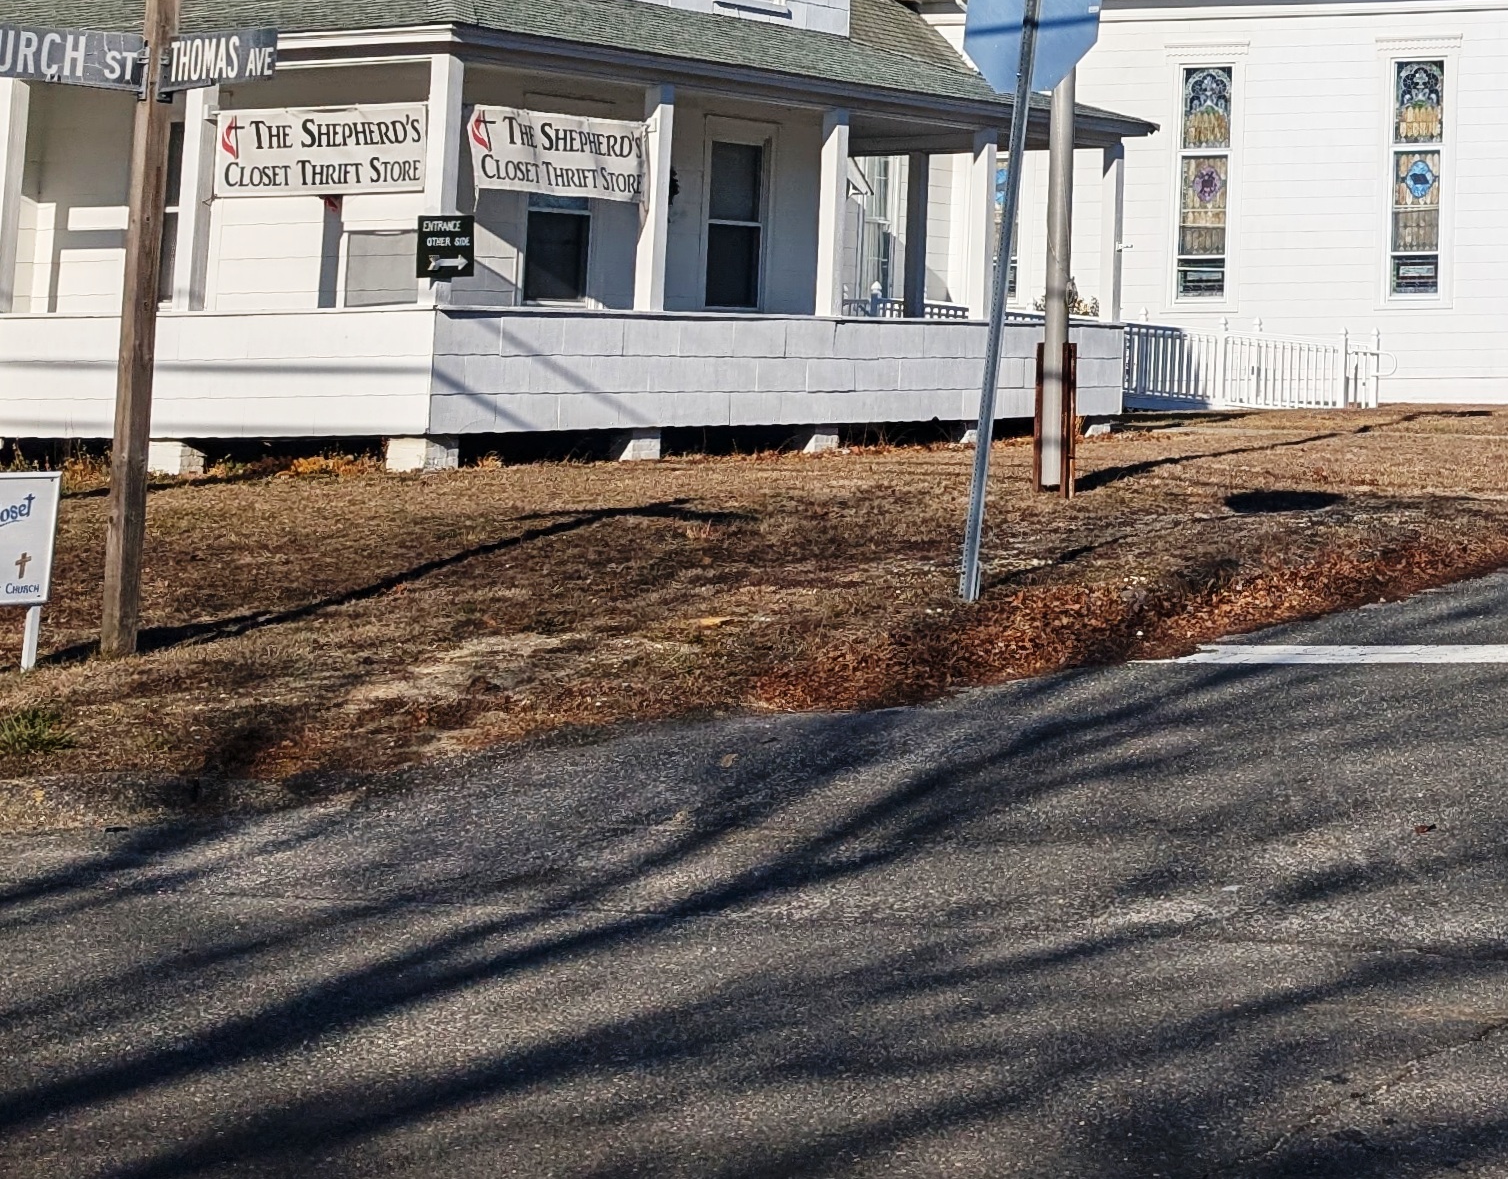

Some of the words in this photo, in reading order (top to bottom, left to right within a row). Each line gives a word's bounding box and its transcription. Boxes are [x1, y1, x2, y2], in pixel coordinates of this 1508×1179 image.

[104, 51, 138, 80] ST
[171, 35, 240, 82] THOMAS
[245, 47, 274, 77] AVE
[250, 120, 293, 150] THE
[301, 114, 422, 148] SHEPHERD'S
[503, 116, 537, 149] THE
[540, 122, 642, 159] SHEPHERD'S
[224, 161, 291, 187] CLOSET
[296, 159, 363, 186] THRIFT
[369, 156, 421, 183] STORE
[481, 154, 541, 183] CLOSET
[542, 161, 599, 189] THRIFT
[600, 166, 643, 194] STORE
[422, 220, 462, 232] ENTRANCE
[426, 236, 452, 247] OTHER
[454, 236, 471, 246] SIDE
[5, 582, 40, 594] CHURCH
